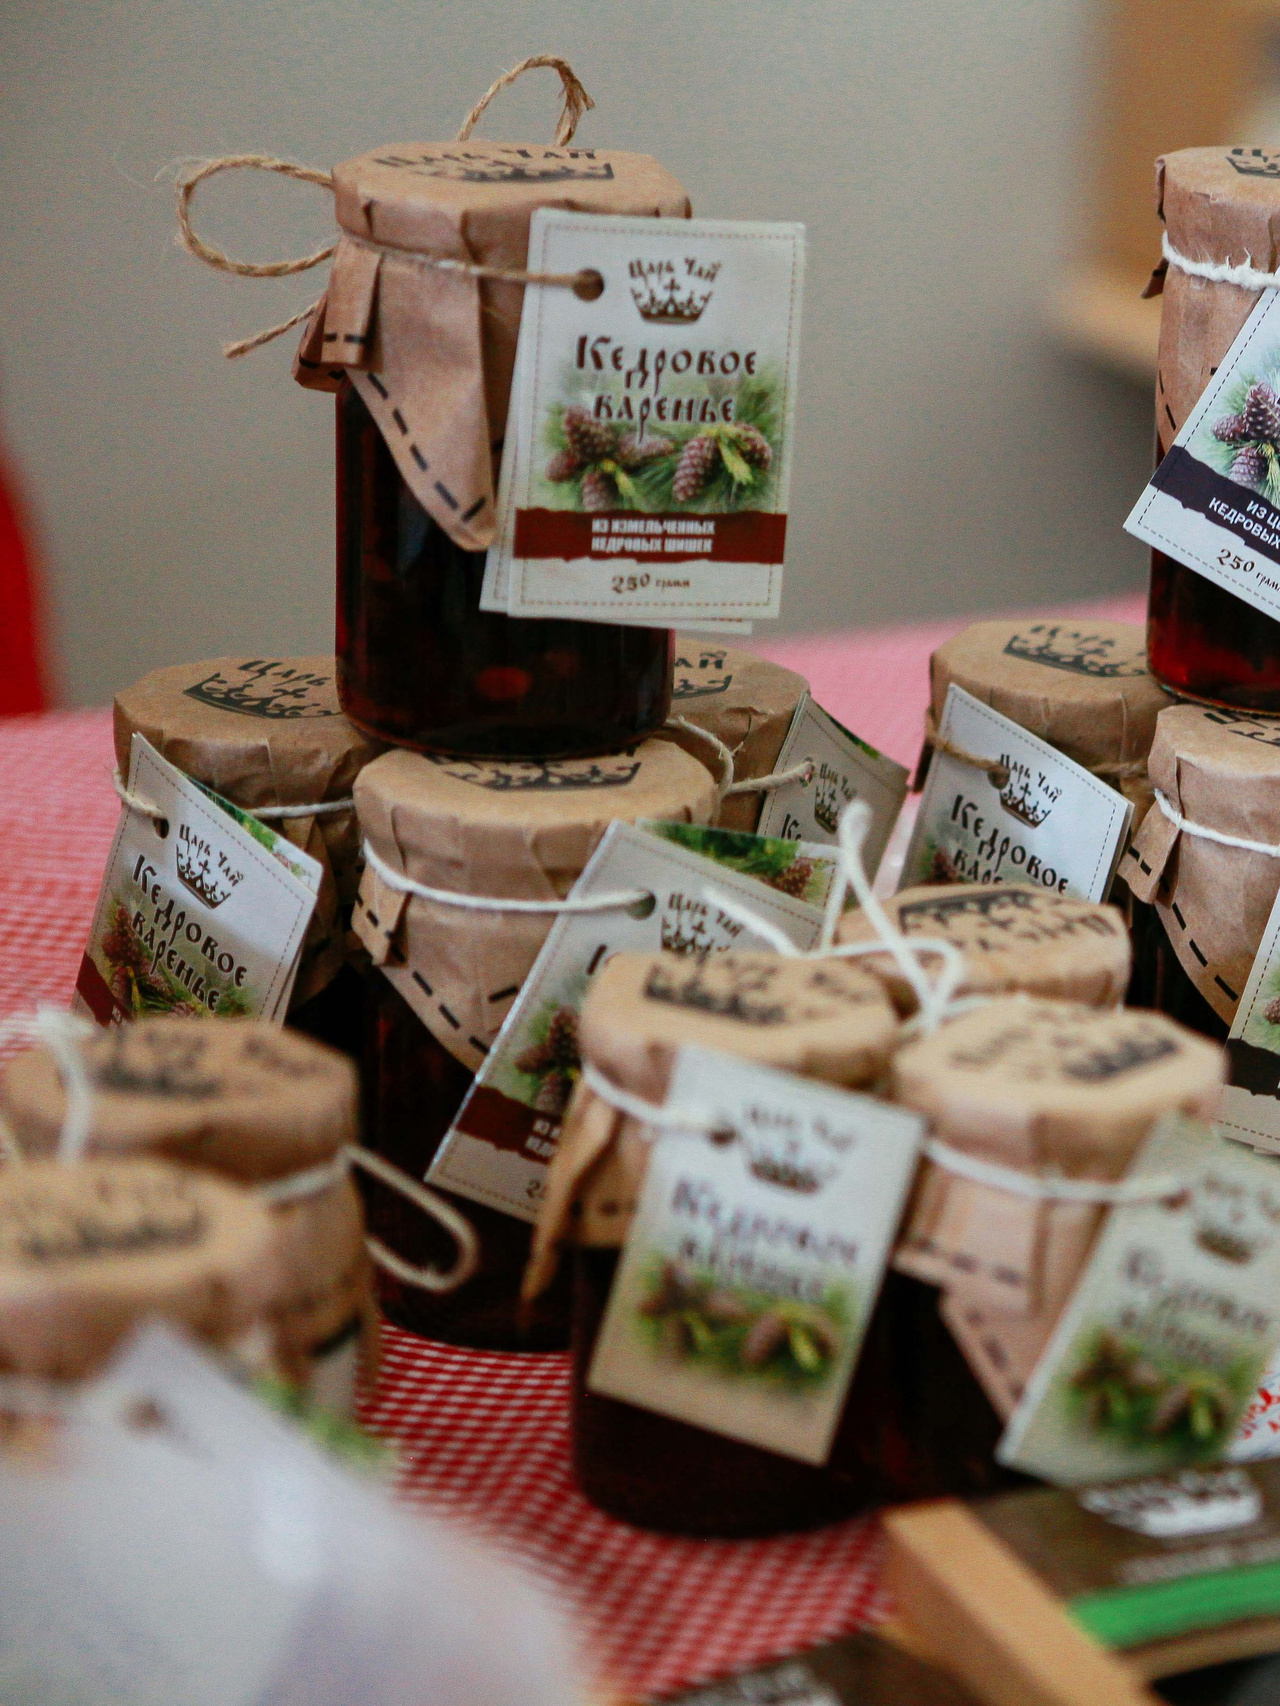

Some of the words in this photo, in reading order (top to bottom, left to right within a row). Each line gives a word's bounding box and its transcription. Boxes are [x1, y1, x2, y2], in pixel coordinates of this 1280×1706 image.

[576, 335, 758, 395] Кедровое
[592, 394, 735, 443] варенье
[1246, 498, 1267, 517] ИЗ
[612, 573, 651, 595] 250
[1216, 546, 1255, 576] 250
[950, 793, 1070, 896] Кедровое
[131, 854, 248, 989] Кедровое
[130, 909, 222, 1013] варенье
